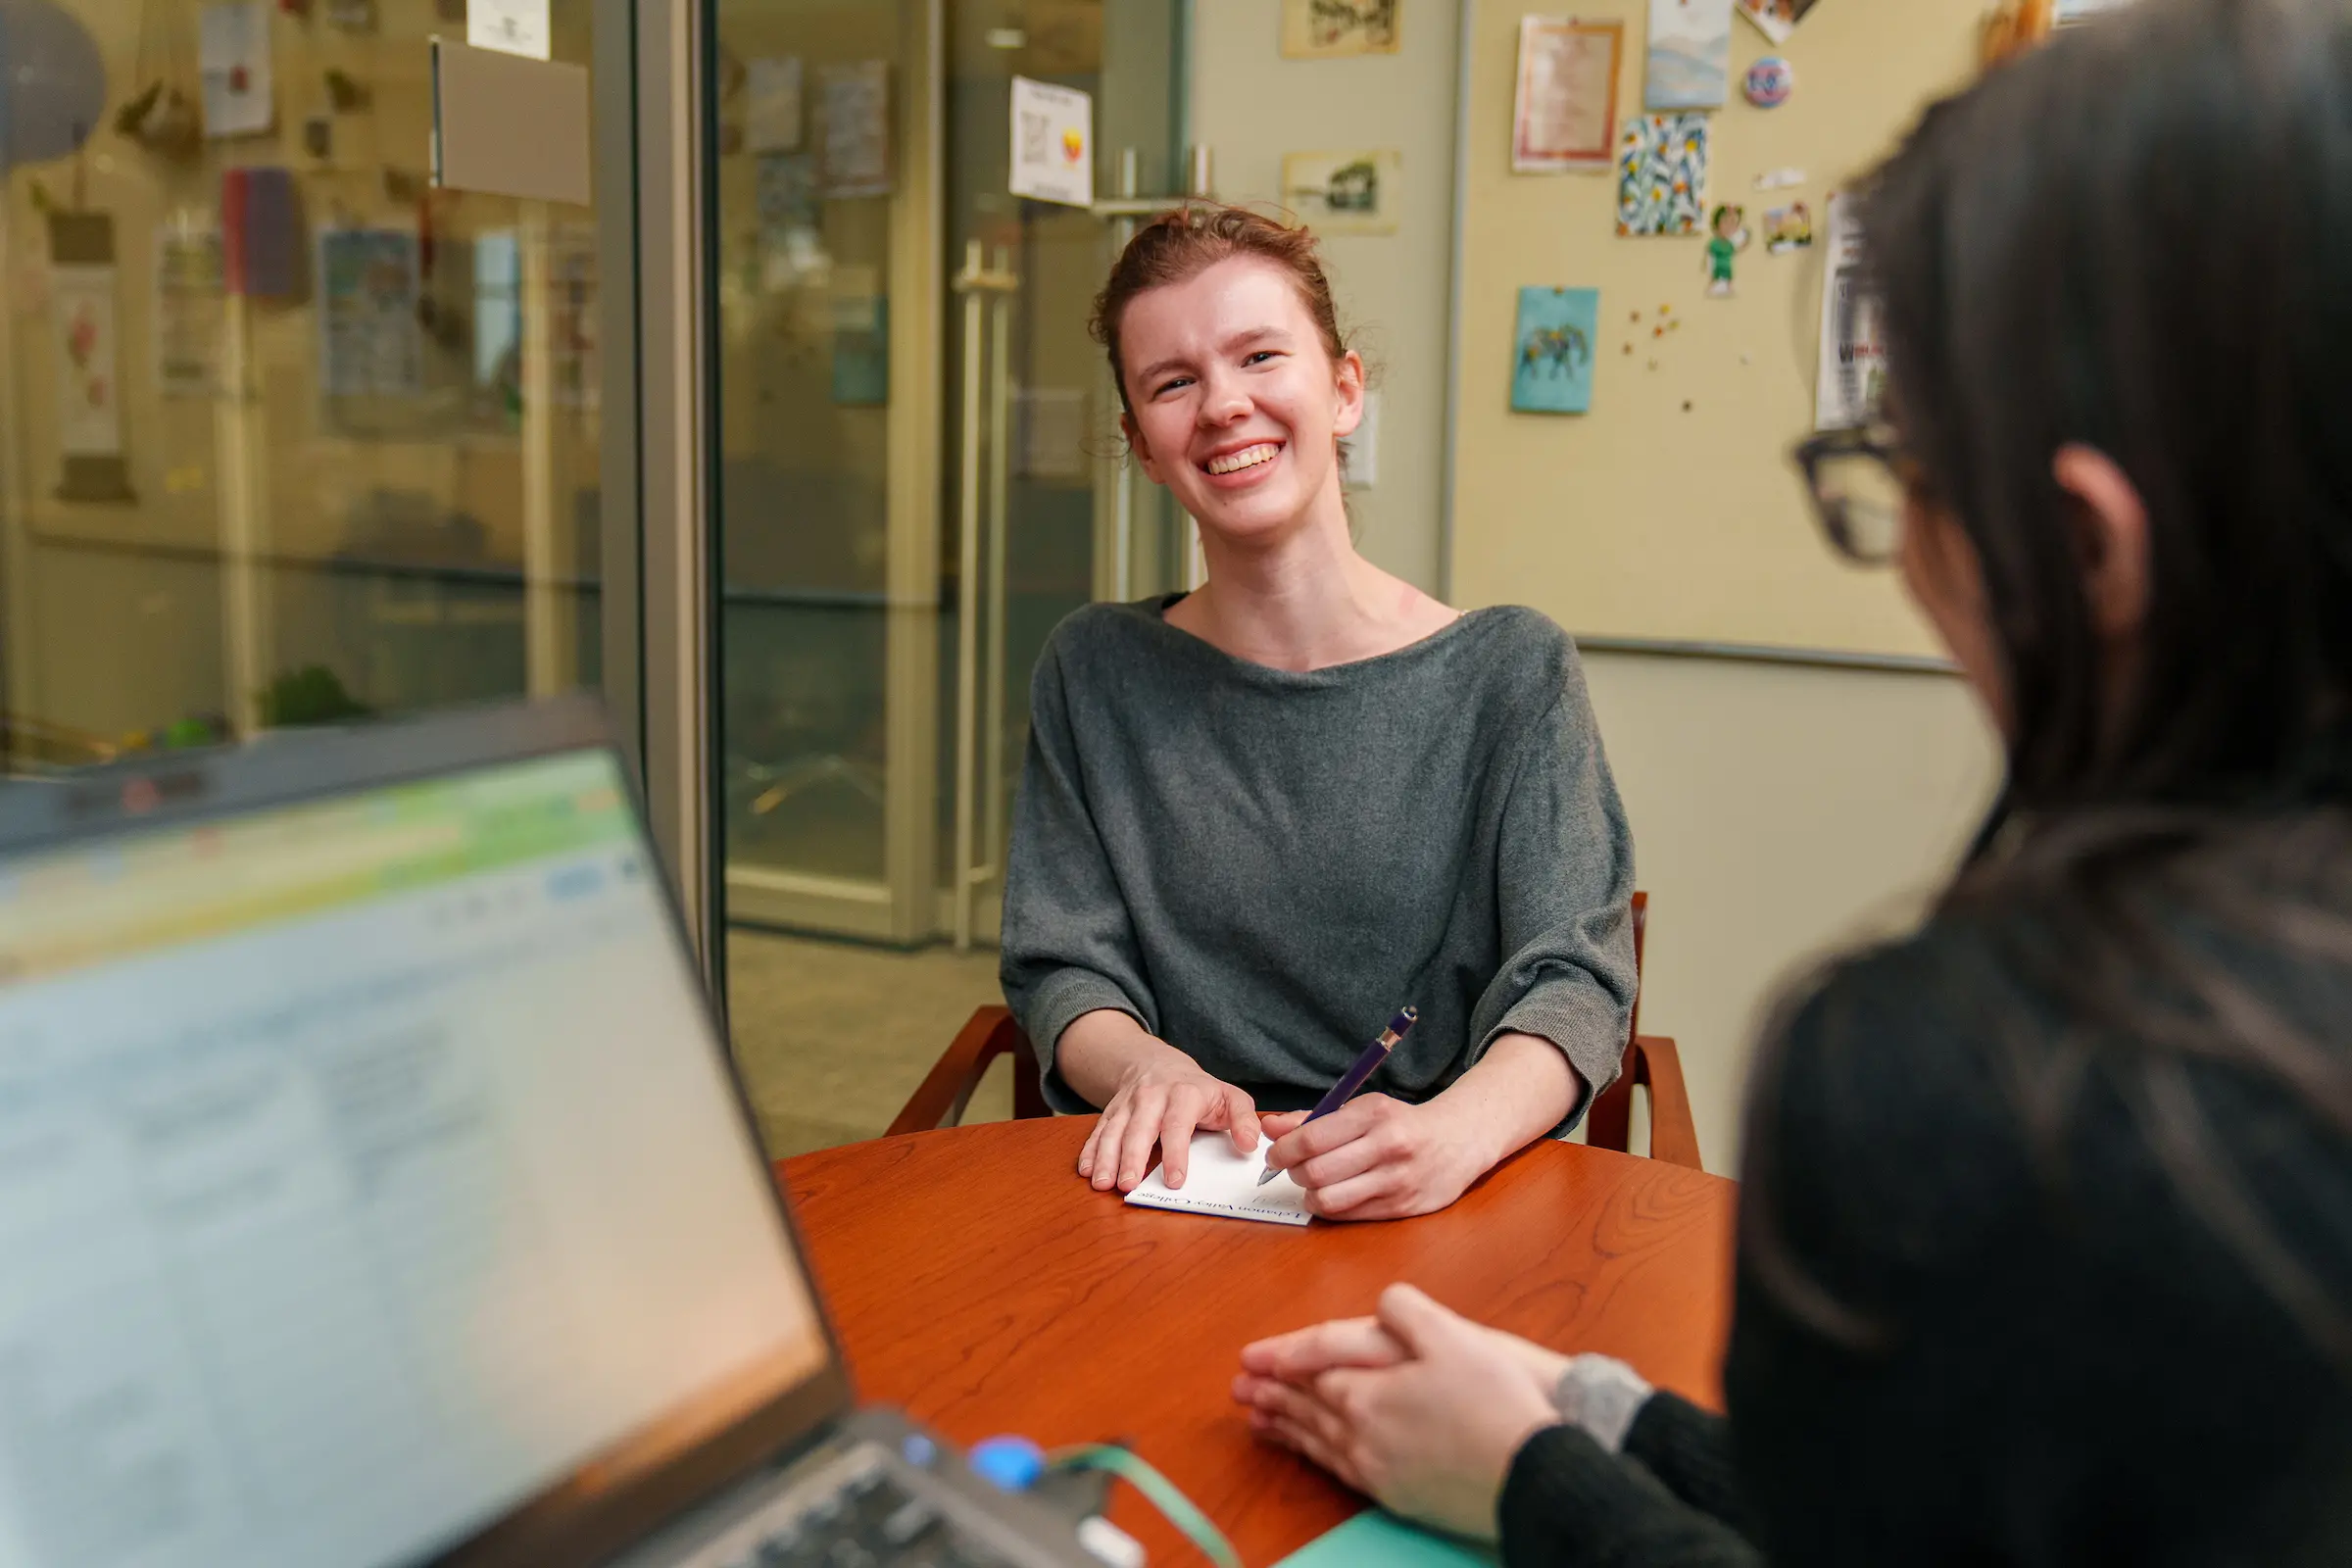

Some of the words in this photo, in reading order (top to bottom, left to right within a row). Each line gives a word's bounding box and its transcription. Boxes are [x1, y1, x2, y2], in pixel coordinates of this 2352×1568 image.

[1137, 1192, 1191, 1203] College
[1195, 1200, 1234, 1210] Valley
[1238, 1205, 1301, 1219] Lebanon
